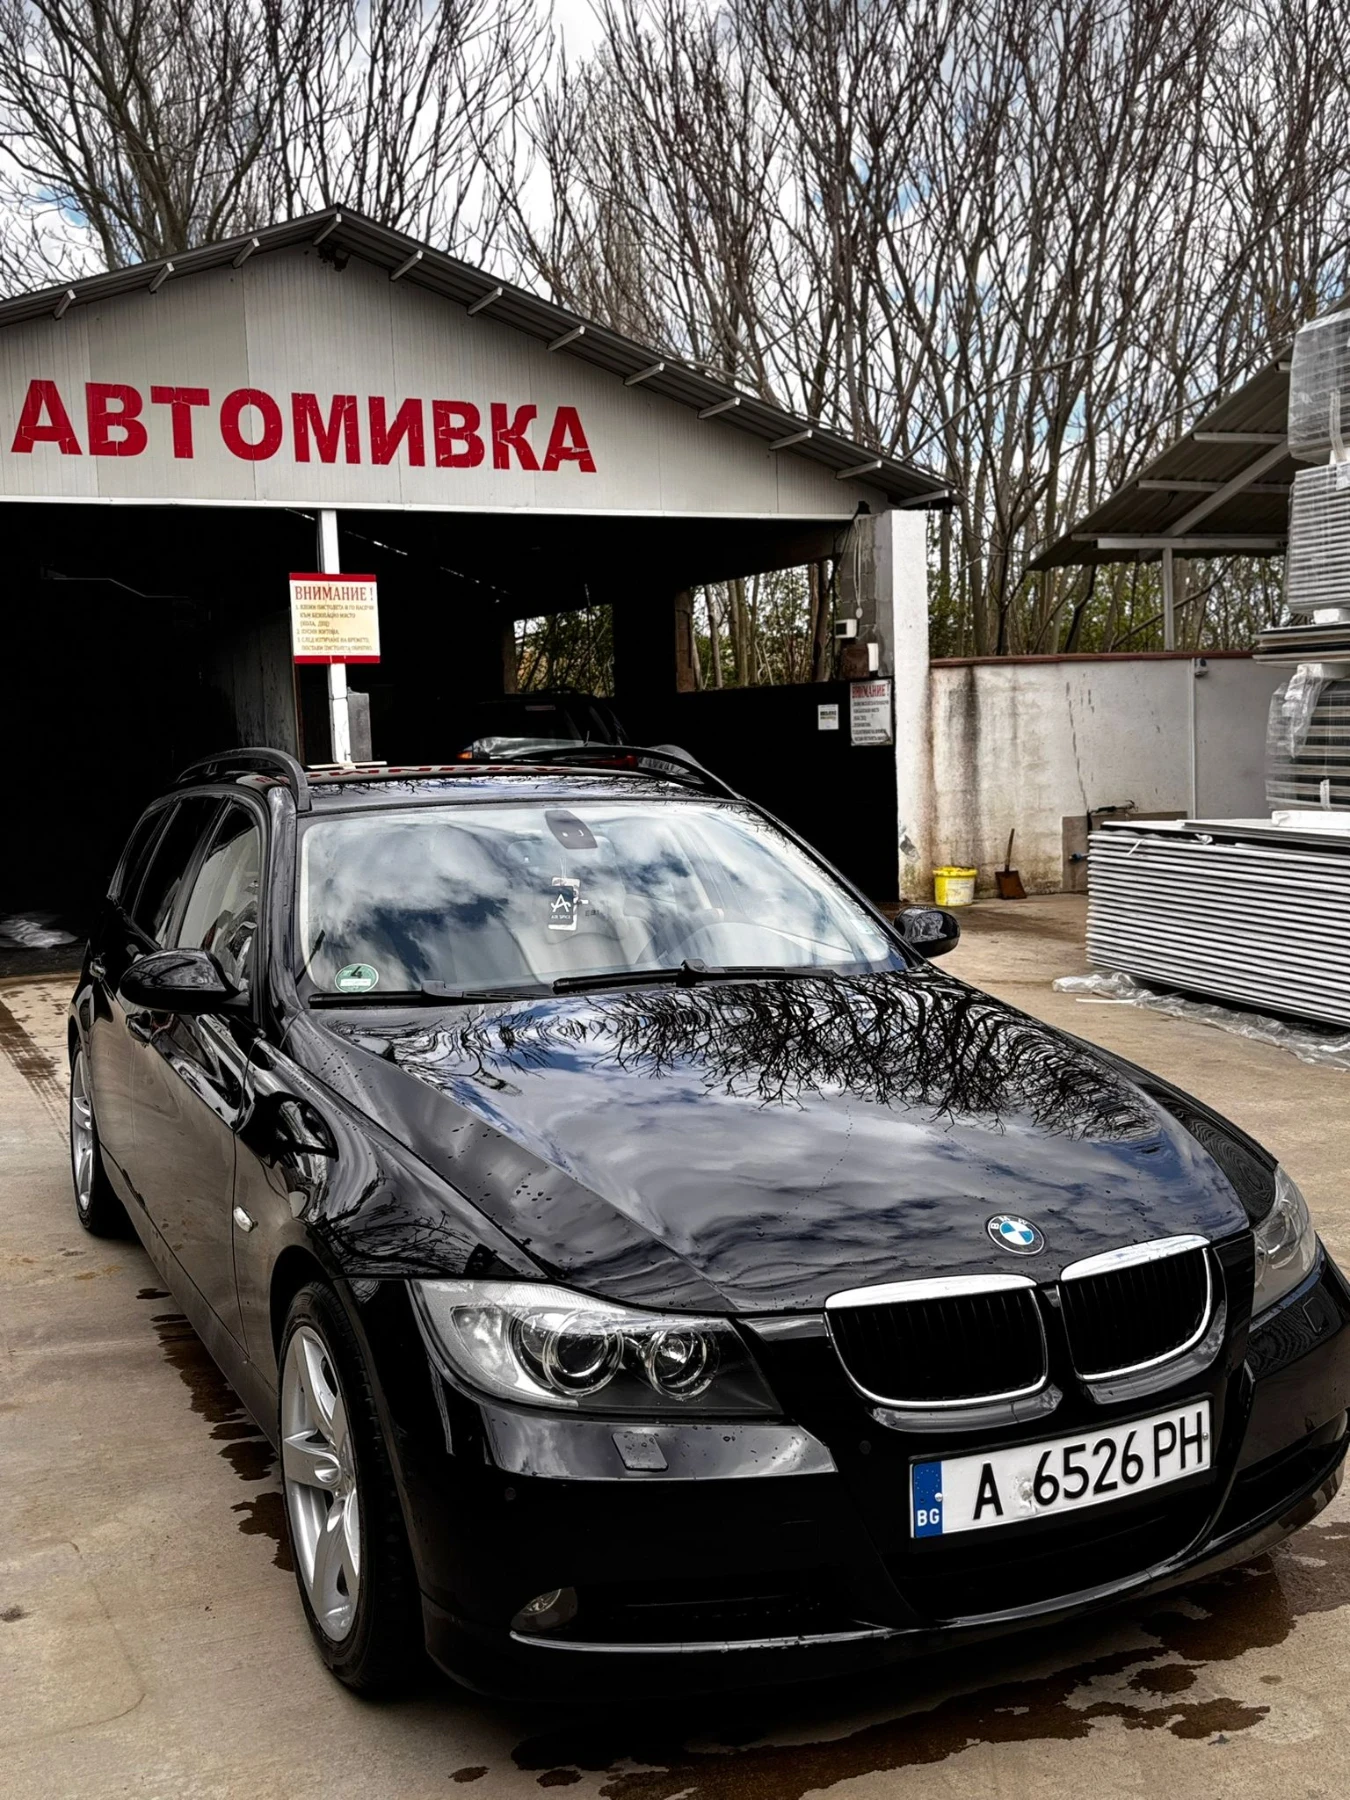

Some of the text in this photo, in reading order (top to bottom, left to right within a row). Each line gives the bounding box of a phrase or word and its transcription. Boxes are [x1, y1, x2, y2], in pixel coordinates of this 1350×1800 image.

[10, 378, 598, 473] АВТОМИВКА
[294, 586, 367, 601] ВНИМАНИЕ
[350, 965, 363, 979] 4
[990, 1215, 1029, 1230] BMW
[972, 1410, 1203, 1521] A 6526 PH
[917, 1508, 940, 1528] BG
